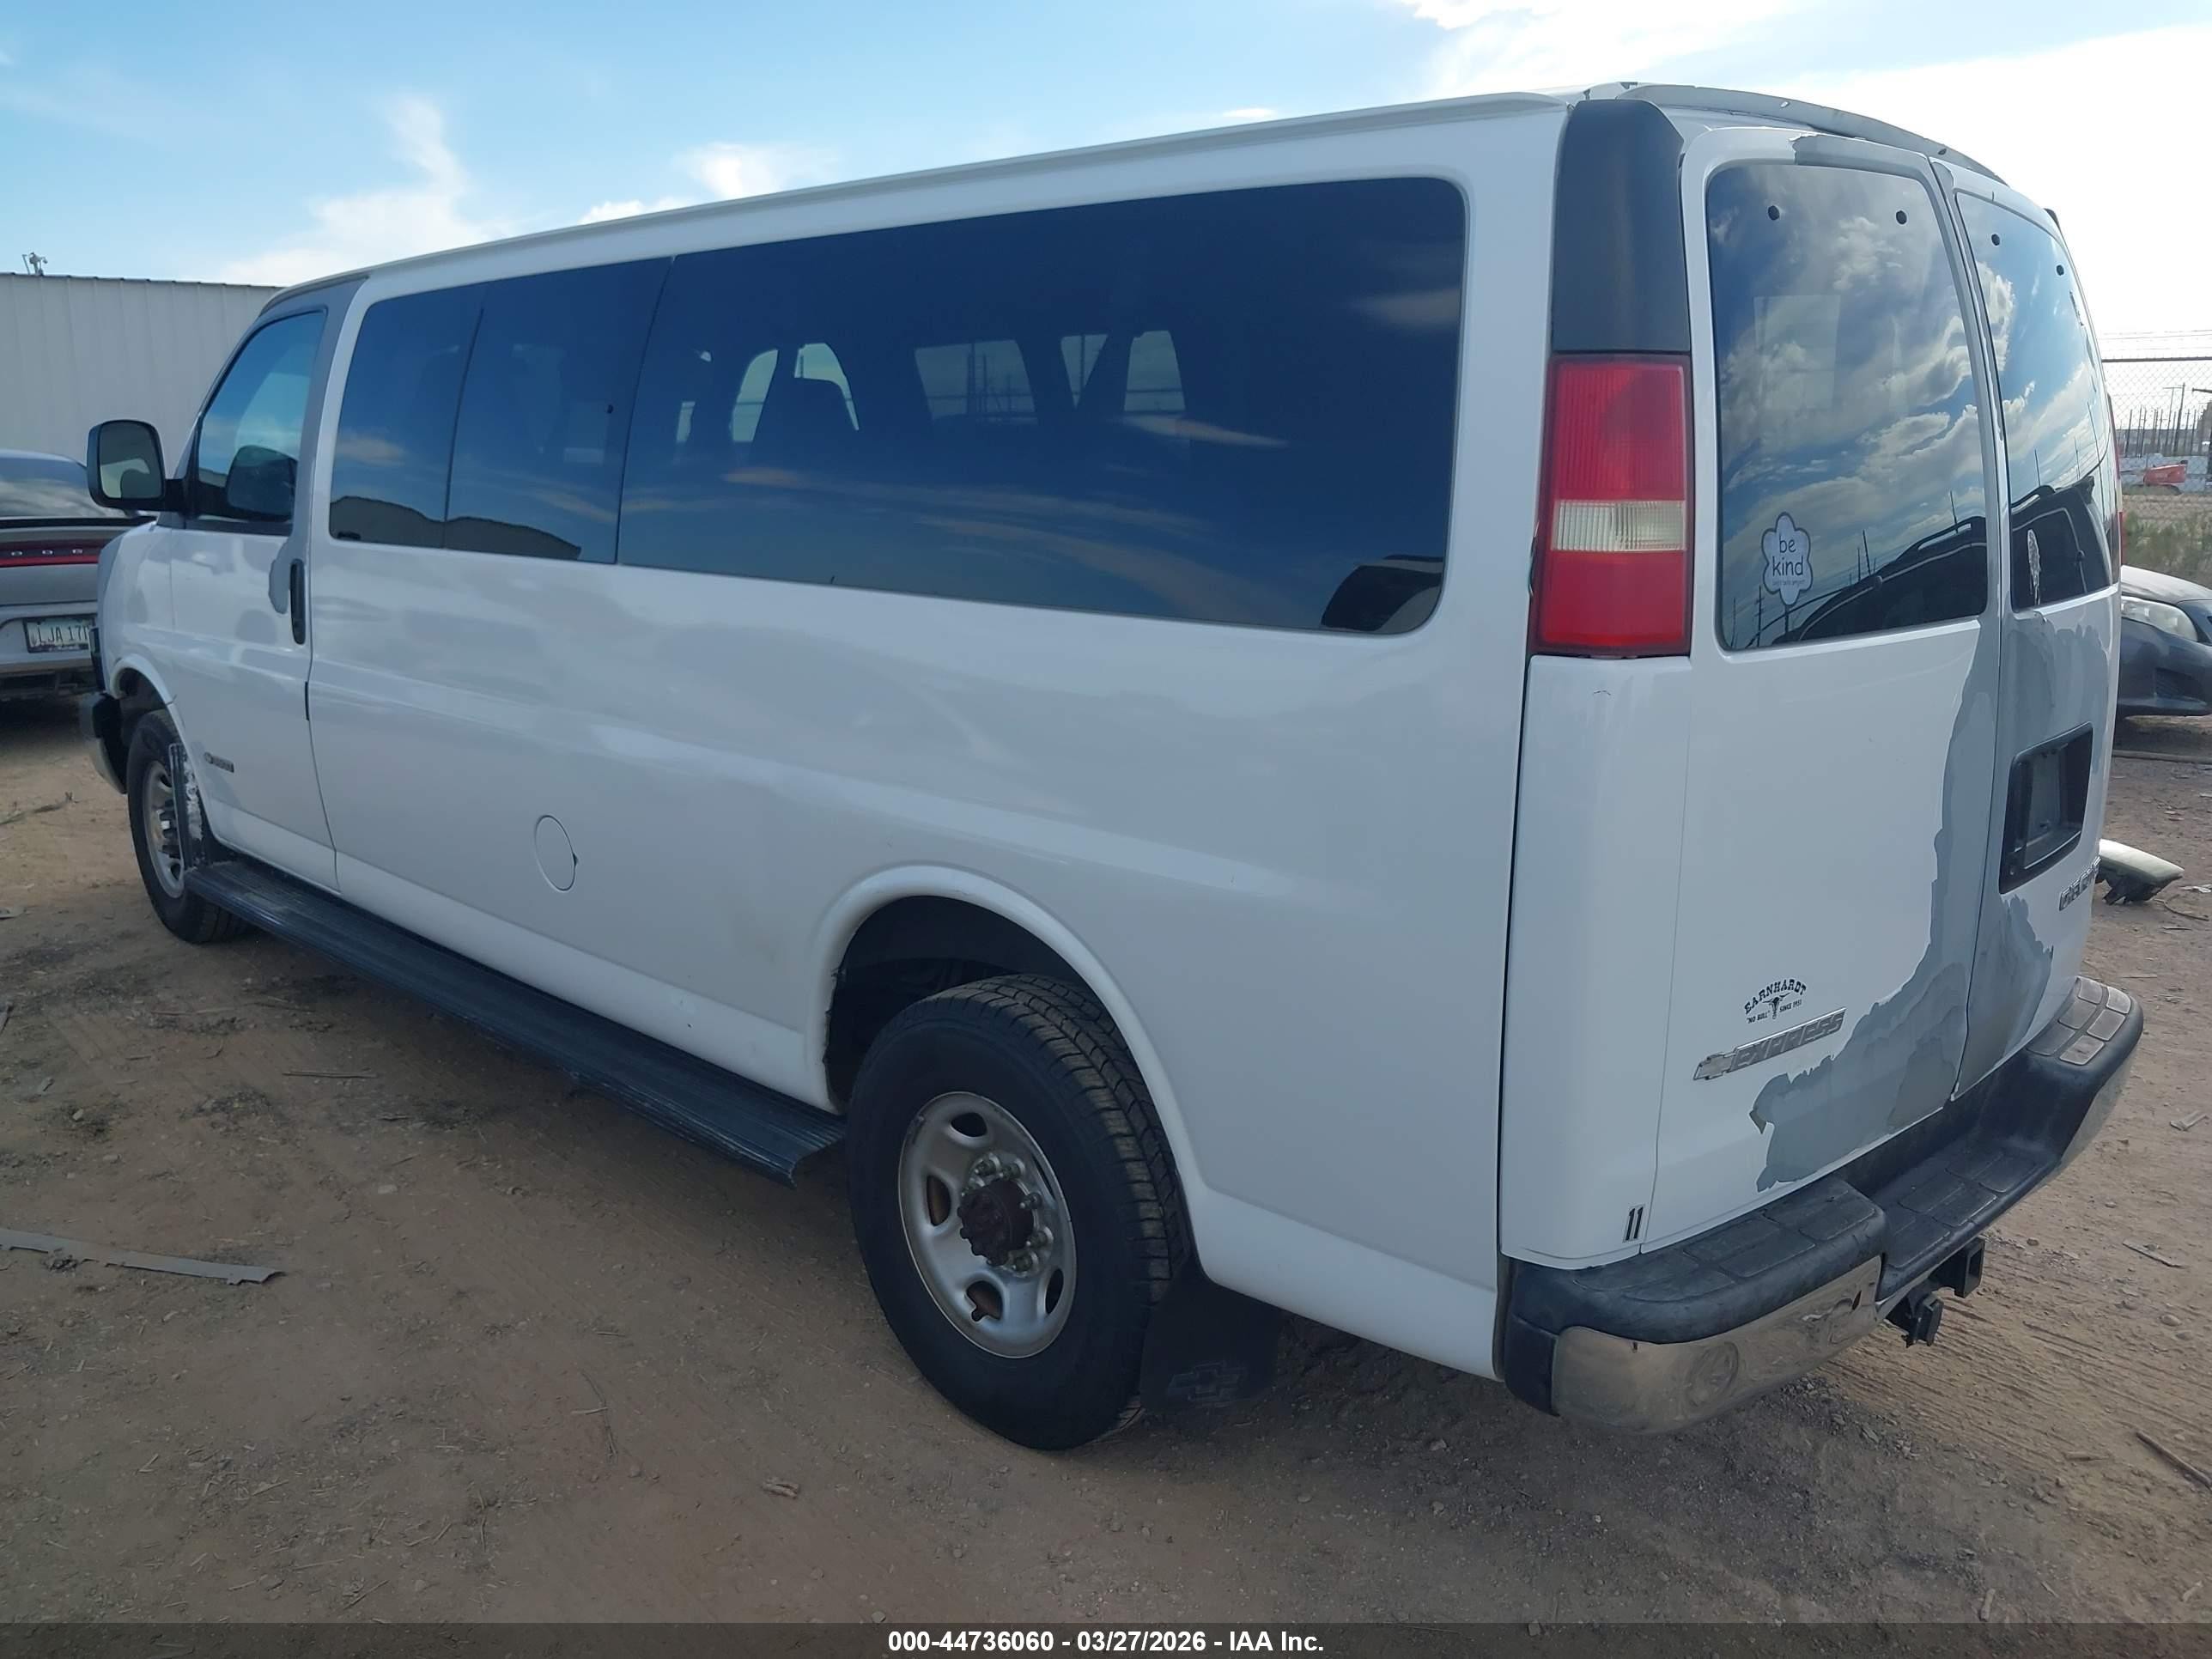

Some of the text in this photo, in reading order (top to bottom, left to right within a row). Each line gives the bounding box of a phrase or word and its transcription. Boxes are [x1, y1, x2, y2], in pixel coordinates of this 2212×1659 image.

[1778, 533, 1796, 553] be
[1771, 556, 1803, 576] kind
[1744, 979, 1807, 1014] EARNHARDT
[1626, 1206, 1644, 1241] 11
